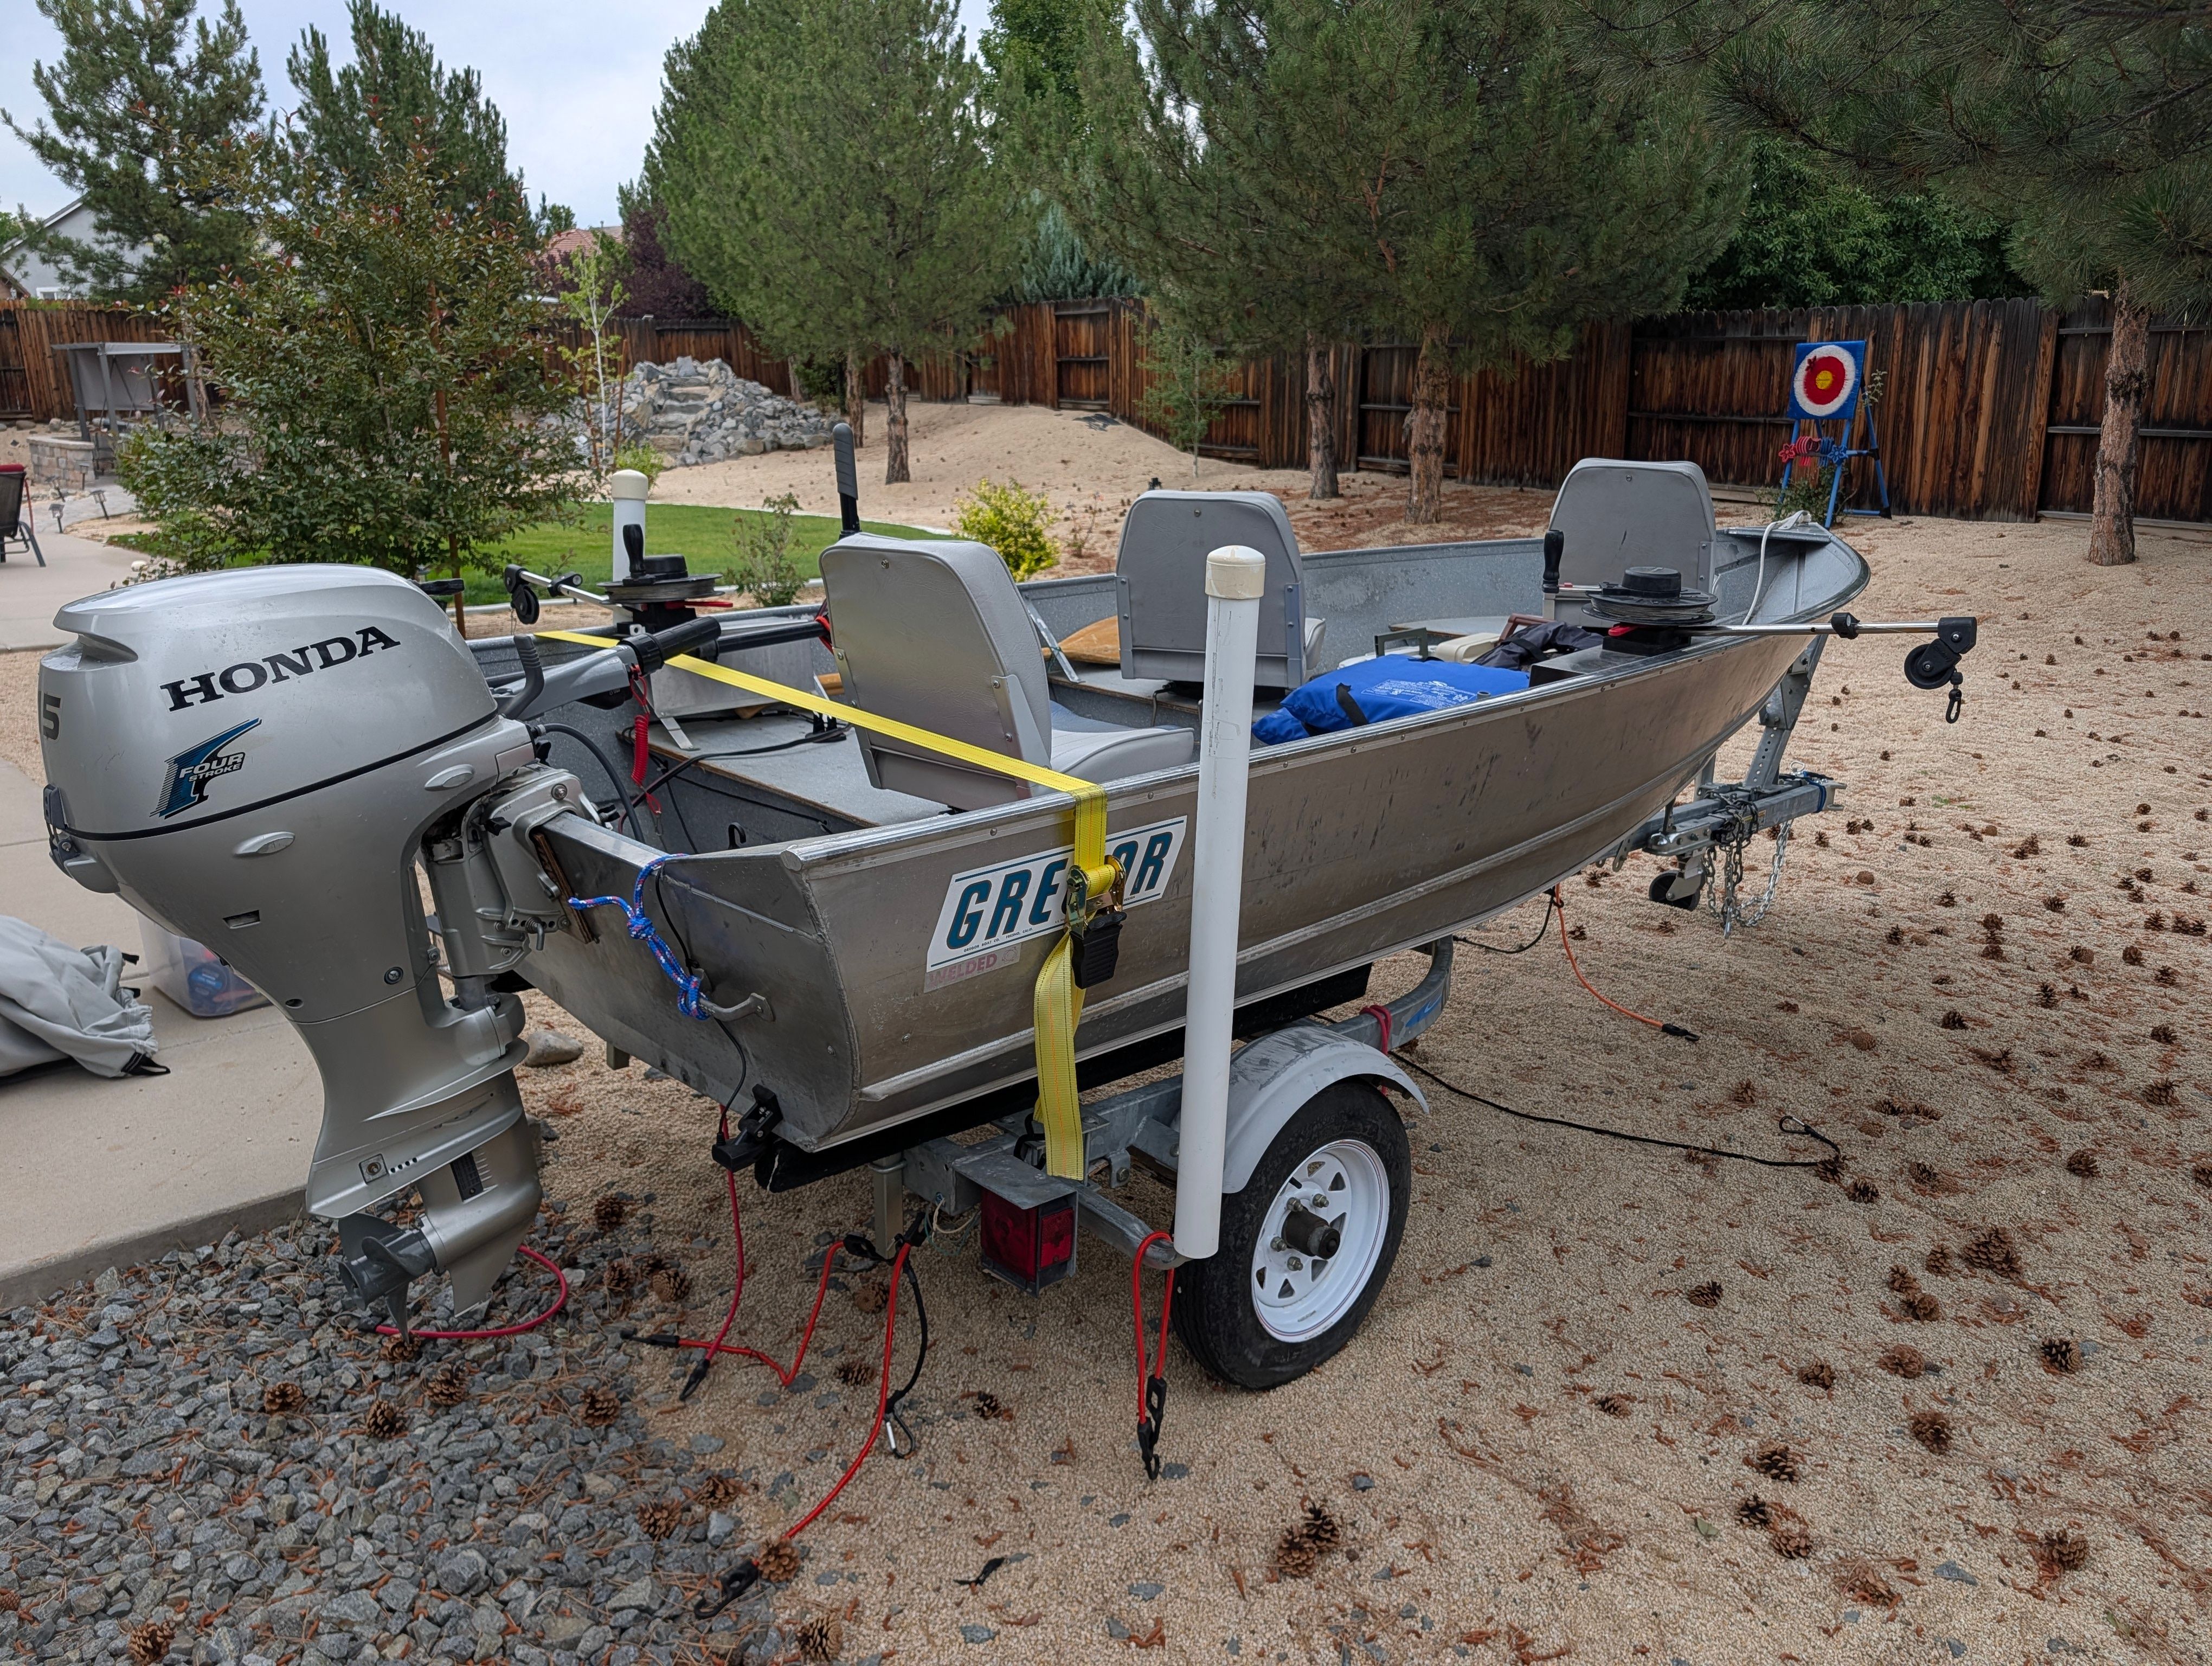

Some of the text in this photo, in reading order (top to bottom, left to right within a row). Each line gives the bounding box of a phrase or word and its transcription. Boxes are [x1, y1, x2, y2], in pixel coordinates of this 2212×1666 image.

[159, 626, 401, 712] HONDA
[179, 753, 244, 779] FOUR
[188, 763, 241, 782] STROKE
[946, 831, 1173, 950] GREOR
[963, 944, 980, 952] GREGOR
[929, 953, 998, 987] WELDED
